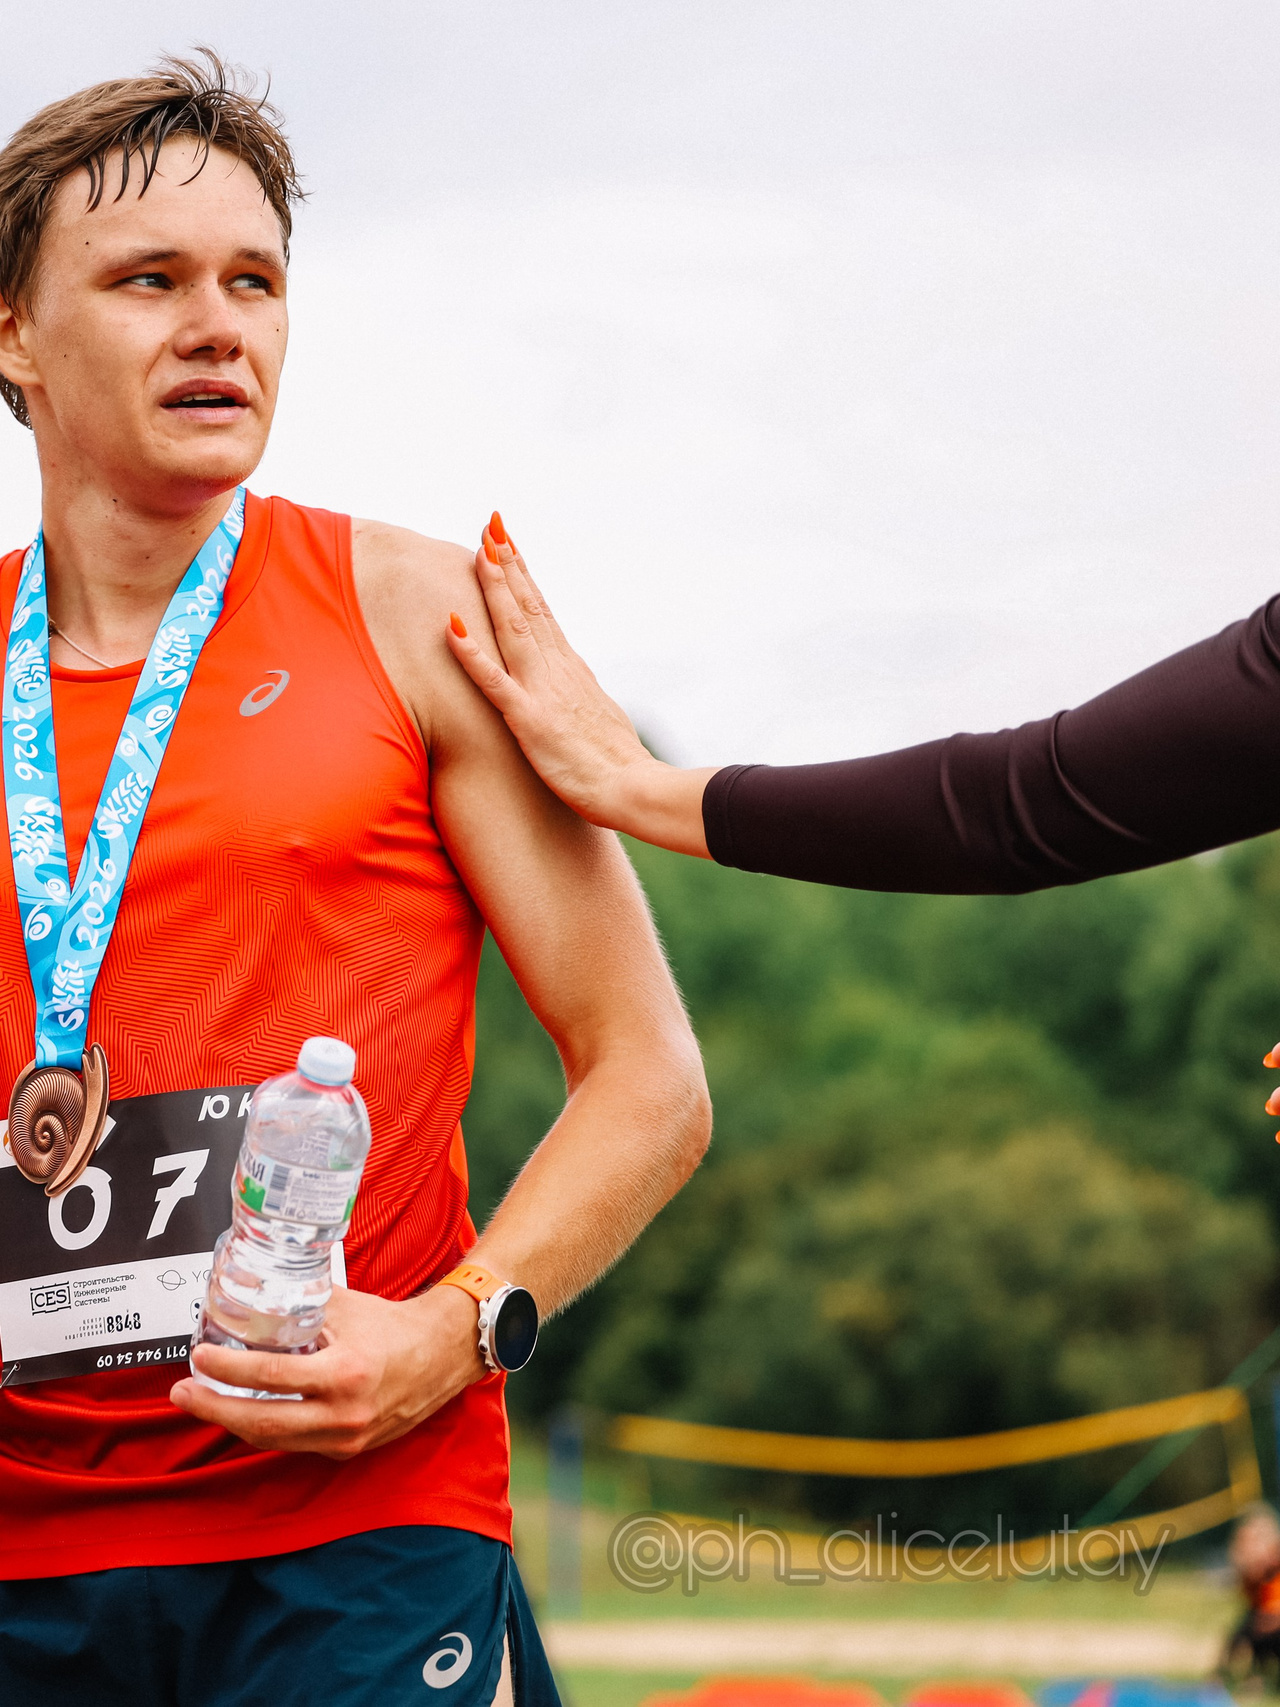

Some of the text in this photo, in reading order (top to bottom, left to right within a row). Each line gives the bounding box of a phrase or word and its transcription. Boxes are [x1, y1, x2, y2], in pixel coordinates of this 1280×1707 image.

[186, 545, 235, 622] 2026
[154, 628, 188, 689] SKILL
[12, 705, 45, 781] 2026
[97, 771, 137, 839] SKILL
[24, 796, 56, 865] SKILL
[76, 855, 117, 949] 2026
[52, 963, 86, 1032] SKILL
[34, 1289, 68, 1308] CES
[72, 1274, 137, 1289] Строительство.
[73, 1284, 127, 1298] Инженерные
[74, 1296, 111, 1307] Системы
[82, 1317, 102, 1325] ЦЕНТР
[106, 1312, 142, 1334] 8848
[96, 1345, 188, 1368] 911 944 54 09
